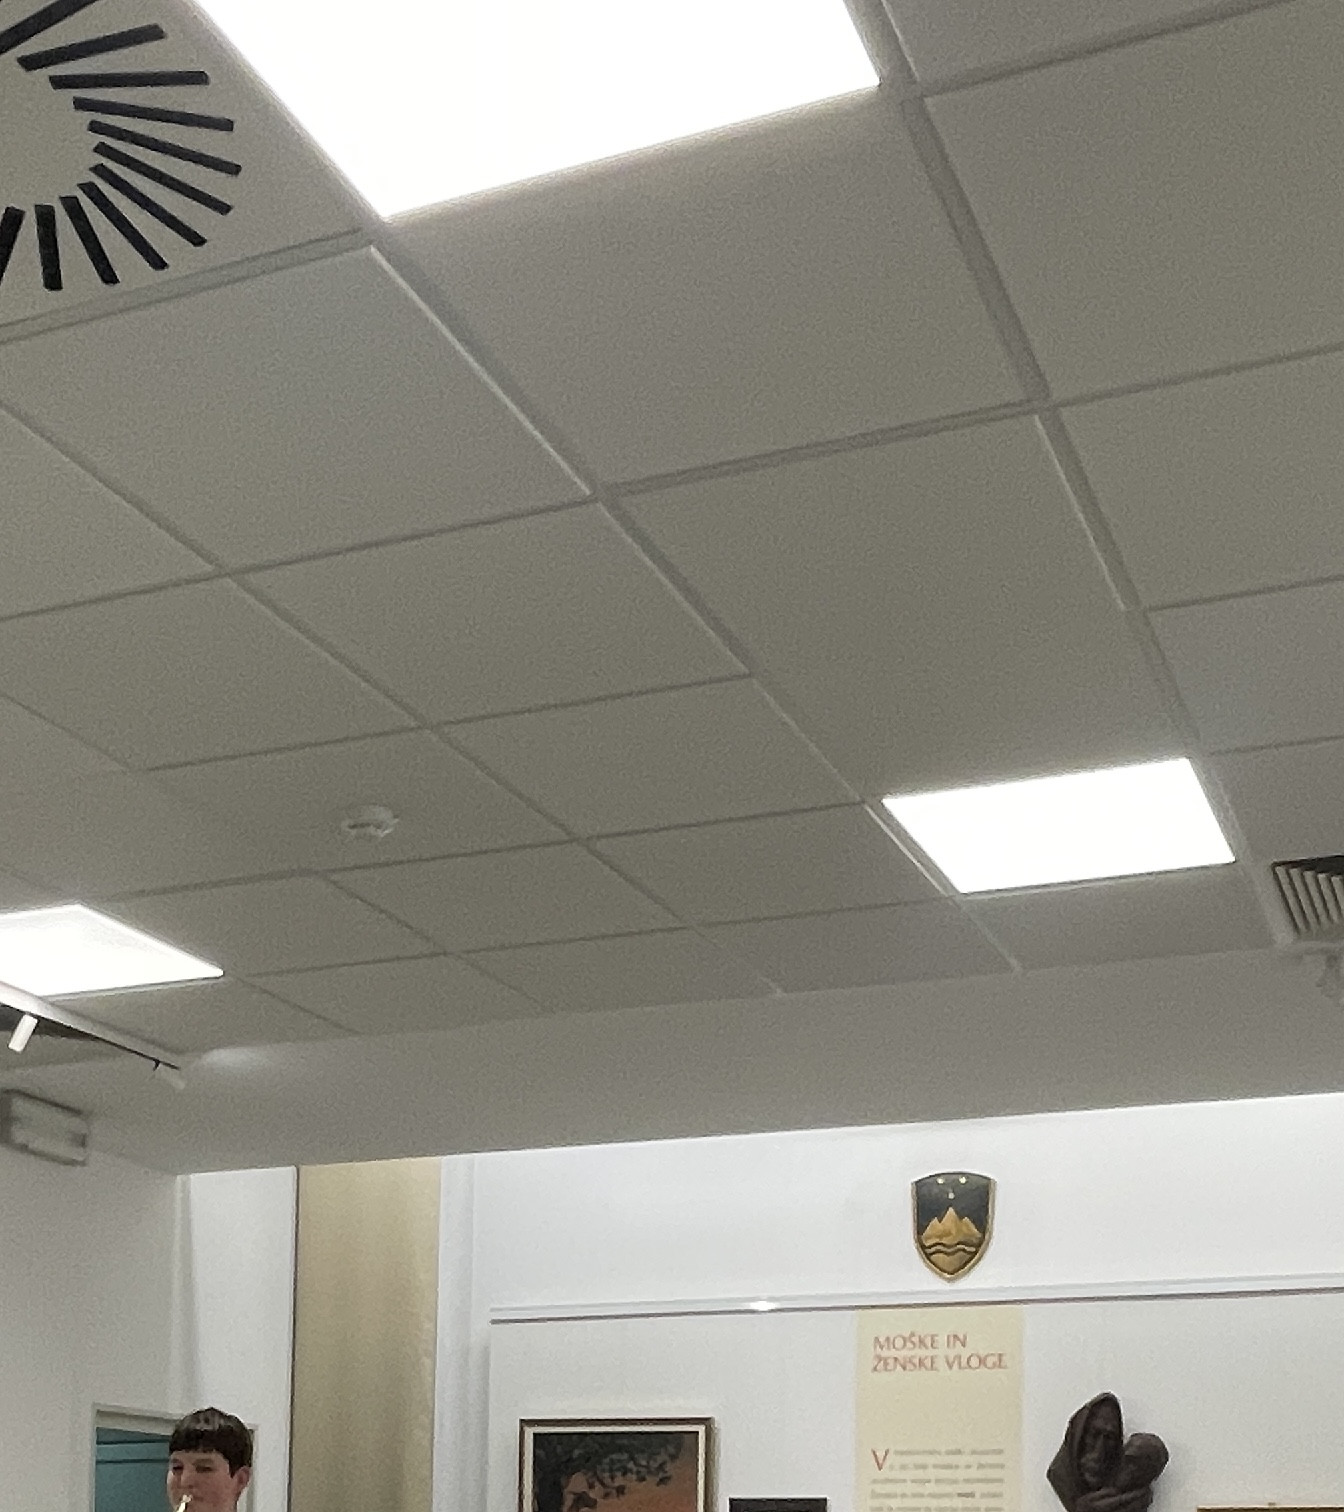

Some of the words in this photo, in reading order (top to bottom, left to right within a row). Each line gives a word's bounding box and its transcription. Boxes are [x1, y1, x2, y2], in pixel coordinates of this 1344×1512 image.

[873, 1331, 939, 1351] MOŠKE
[946, 1333, 967, 1349] IN
[871, 1354, 940, 1373] ŽENSKE
[944, 1352, 1008, 1371] VLOGE
